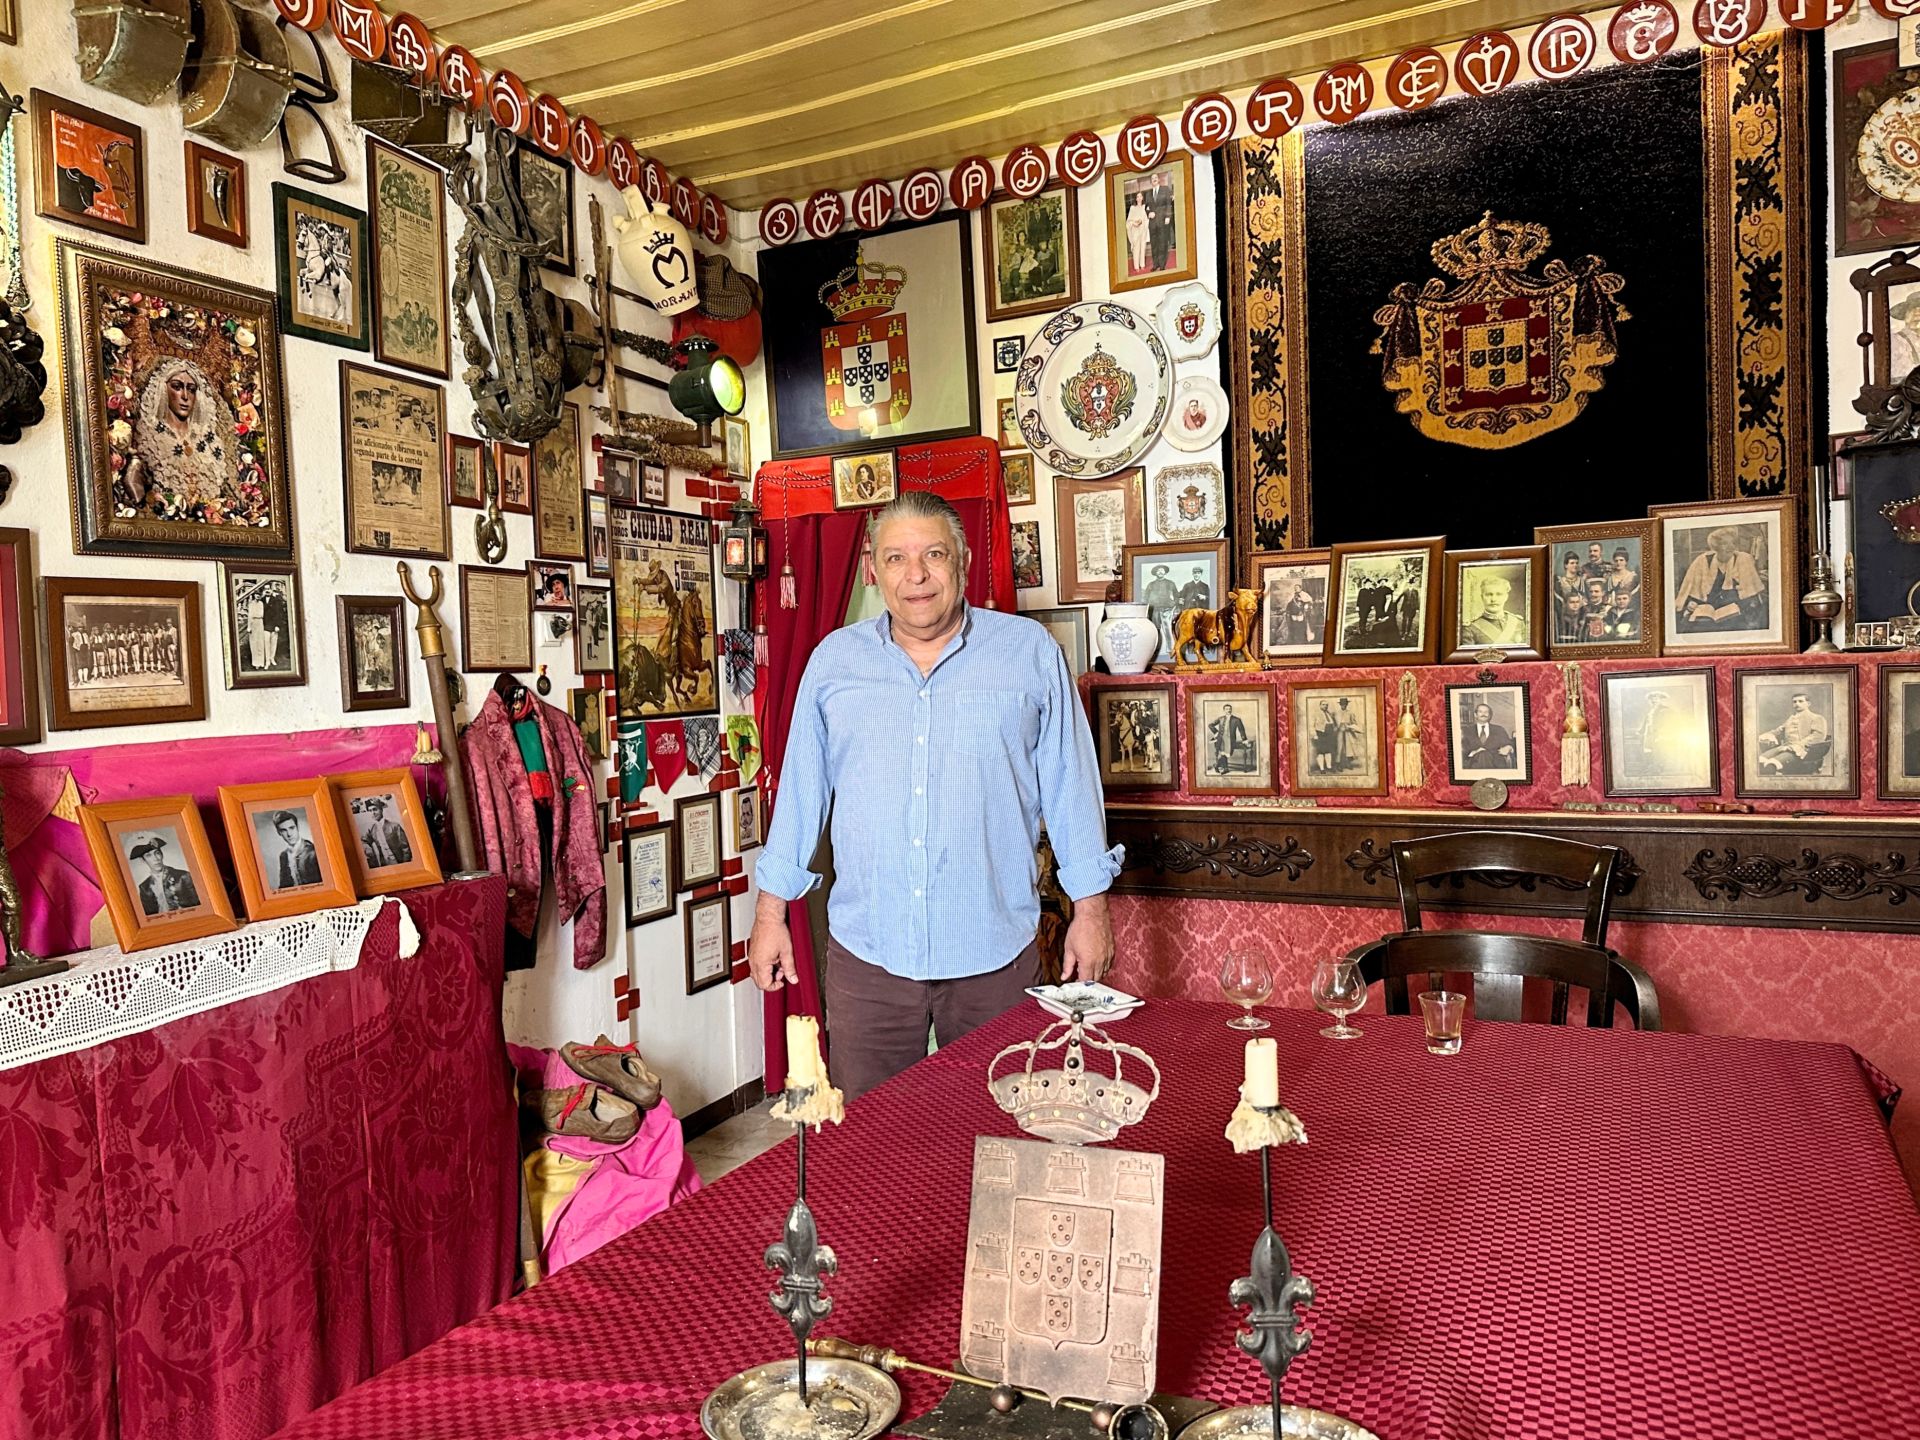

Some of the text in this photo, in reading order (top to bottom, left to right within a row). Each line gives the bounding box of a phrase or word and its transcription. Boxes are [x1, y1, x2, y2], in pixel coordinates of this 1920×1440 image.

[1199, 110, 1222, 138] B
[1071, 147, 1095, 174] G
[911, 182, 939, 211] PD
[353, 436, 363, 445] Los
[364, 439, 393, 451] aficionados
[394, 444, 416, 454] vibraron
[353, 447, 375, 457] segunda
[376, 451, 389, 460] parte
[391, 452, 397, 461] de
[405, 456, 423, 466] corrida
[630, 511, 708, 548] CIUDAD REAL
[674, 560, 680, 591] 5
